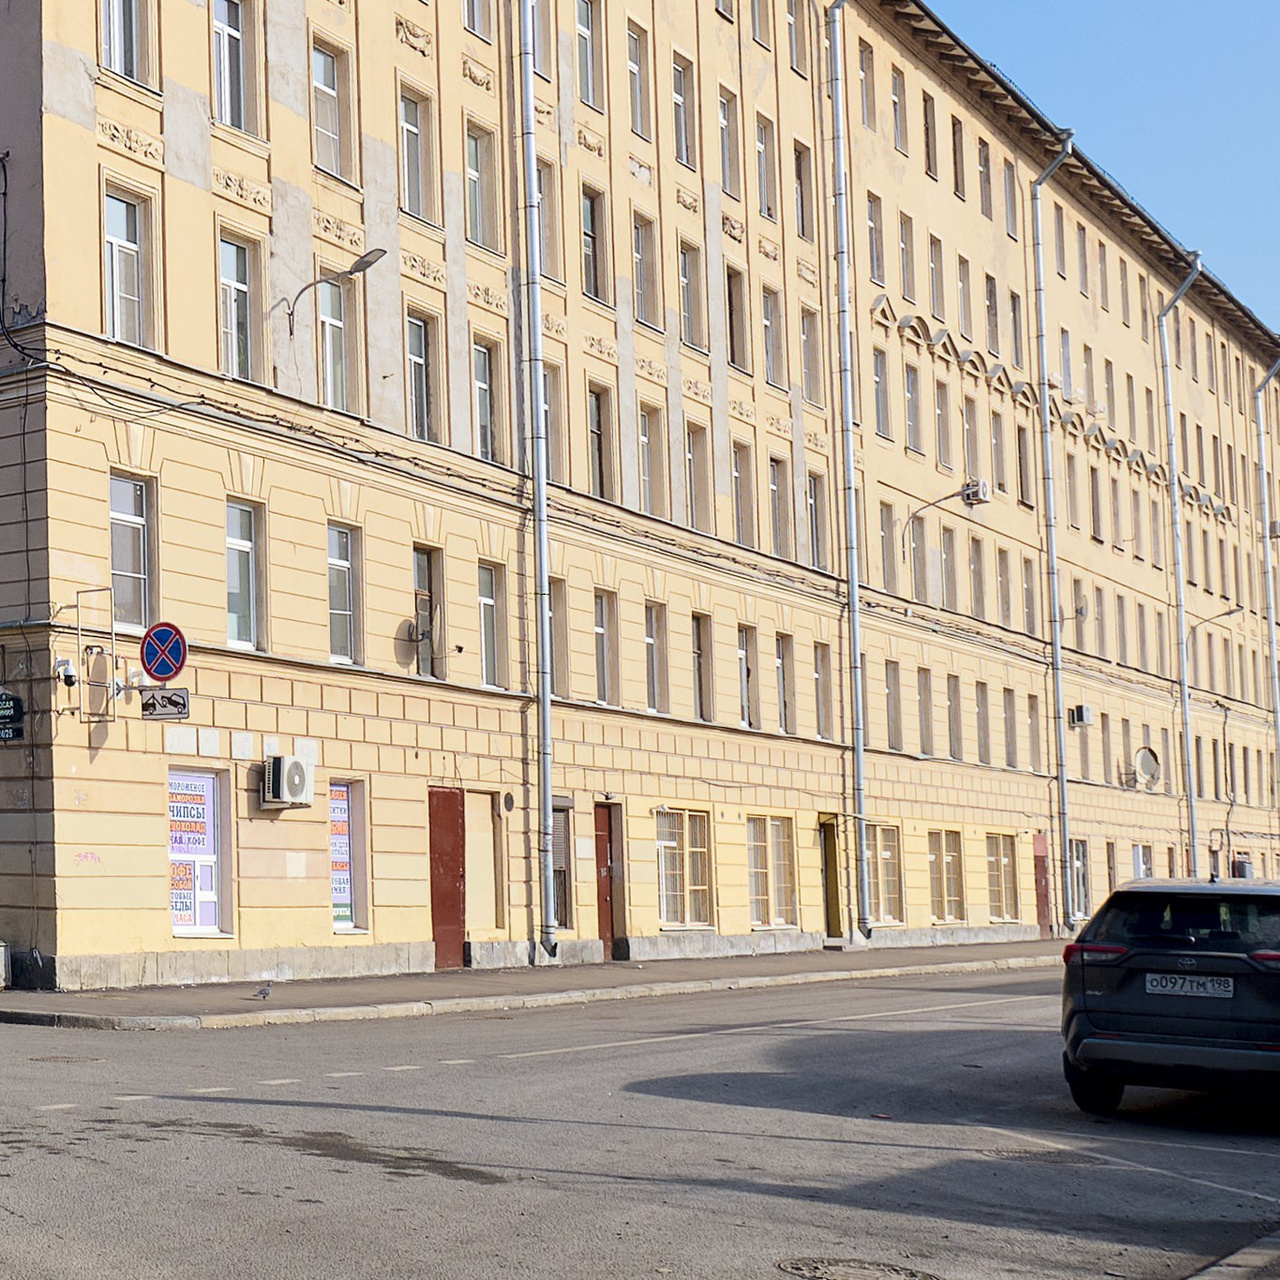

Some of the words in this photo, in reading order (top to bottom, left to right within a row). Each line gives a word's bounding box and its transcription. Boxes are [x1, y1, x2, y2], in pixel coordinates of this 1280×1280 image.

[169, 805, 206, 820] ЧИПСЫ
[169, 820, 207, 835] ШОКОЛАД
[170, 863, 192, 878] ОФЕ
[174, 913, 193, 924] ЧАСА
